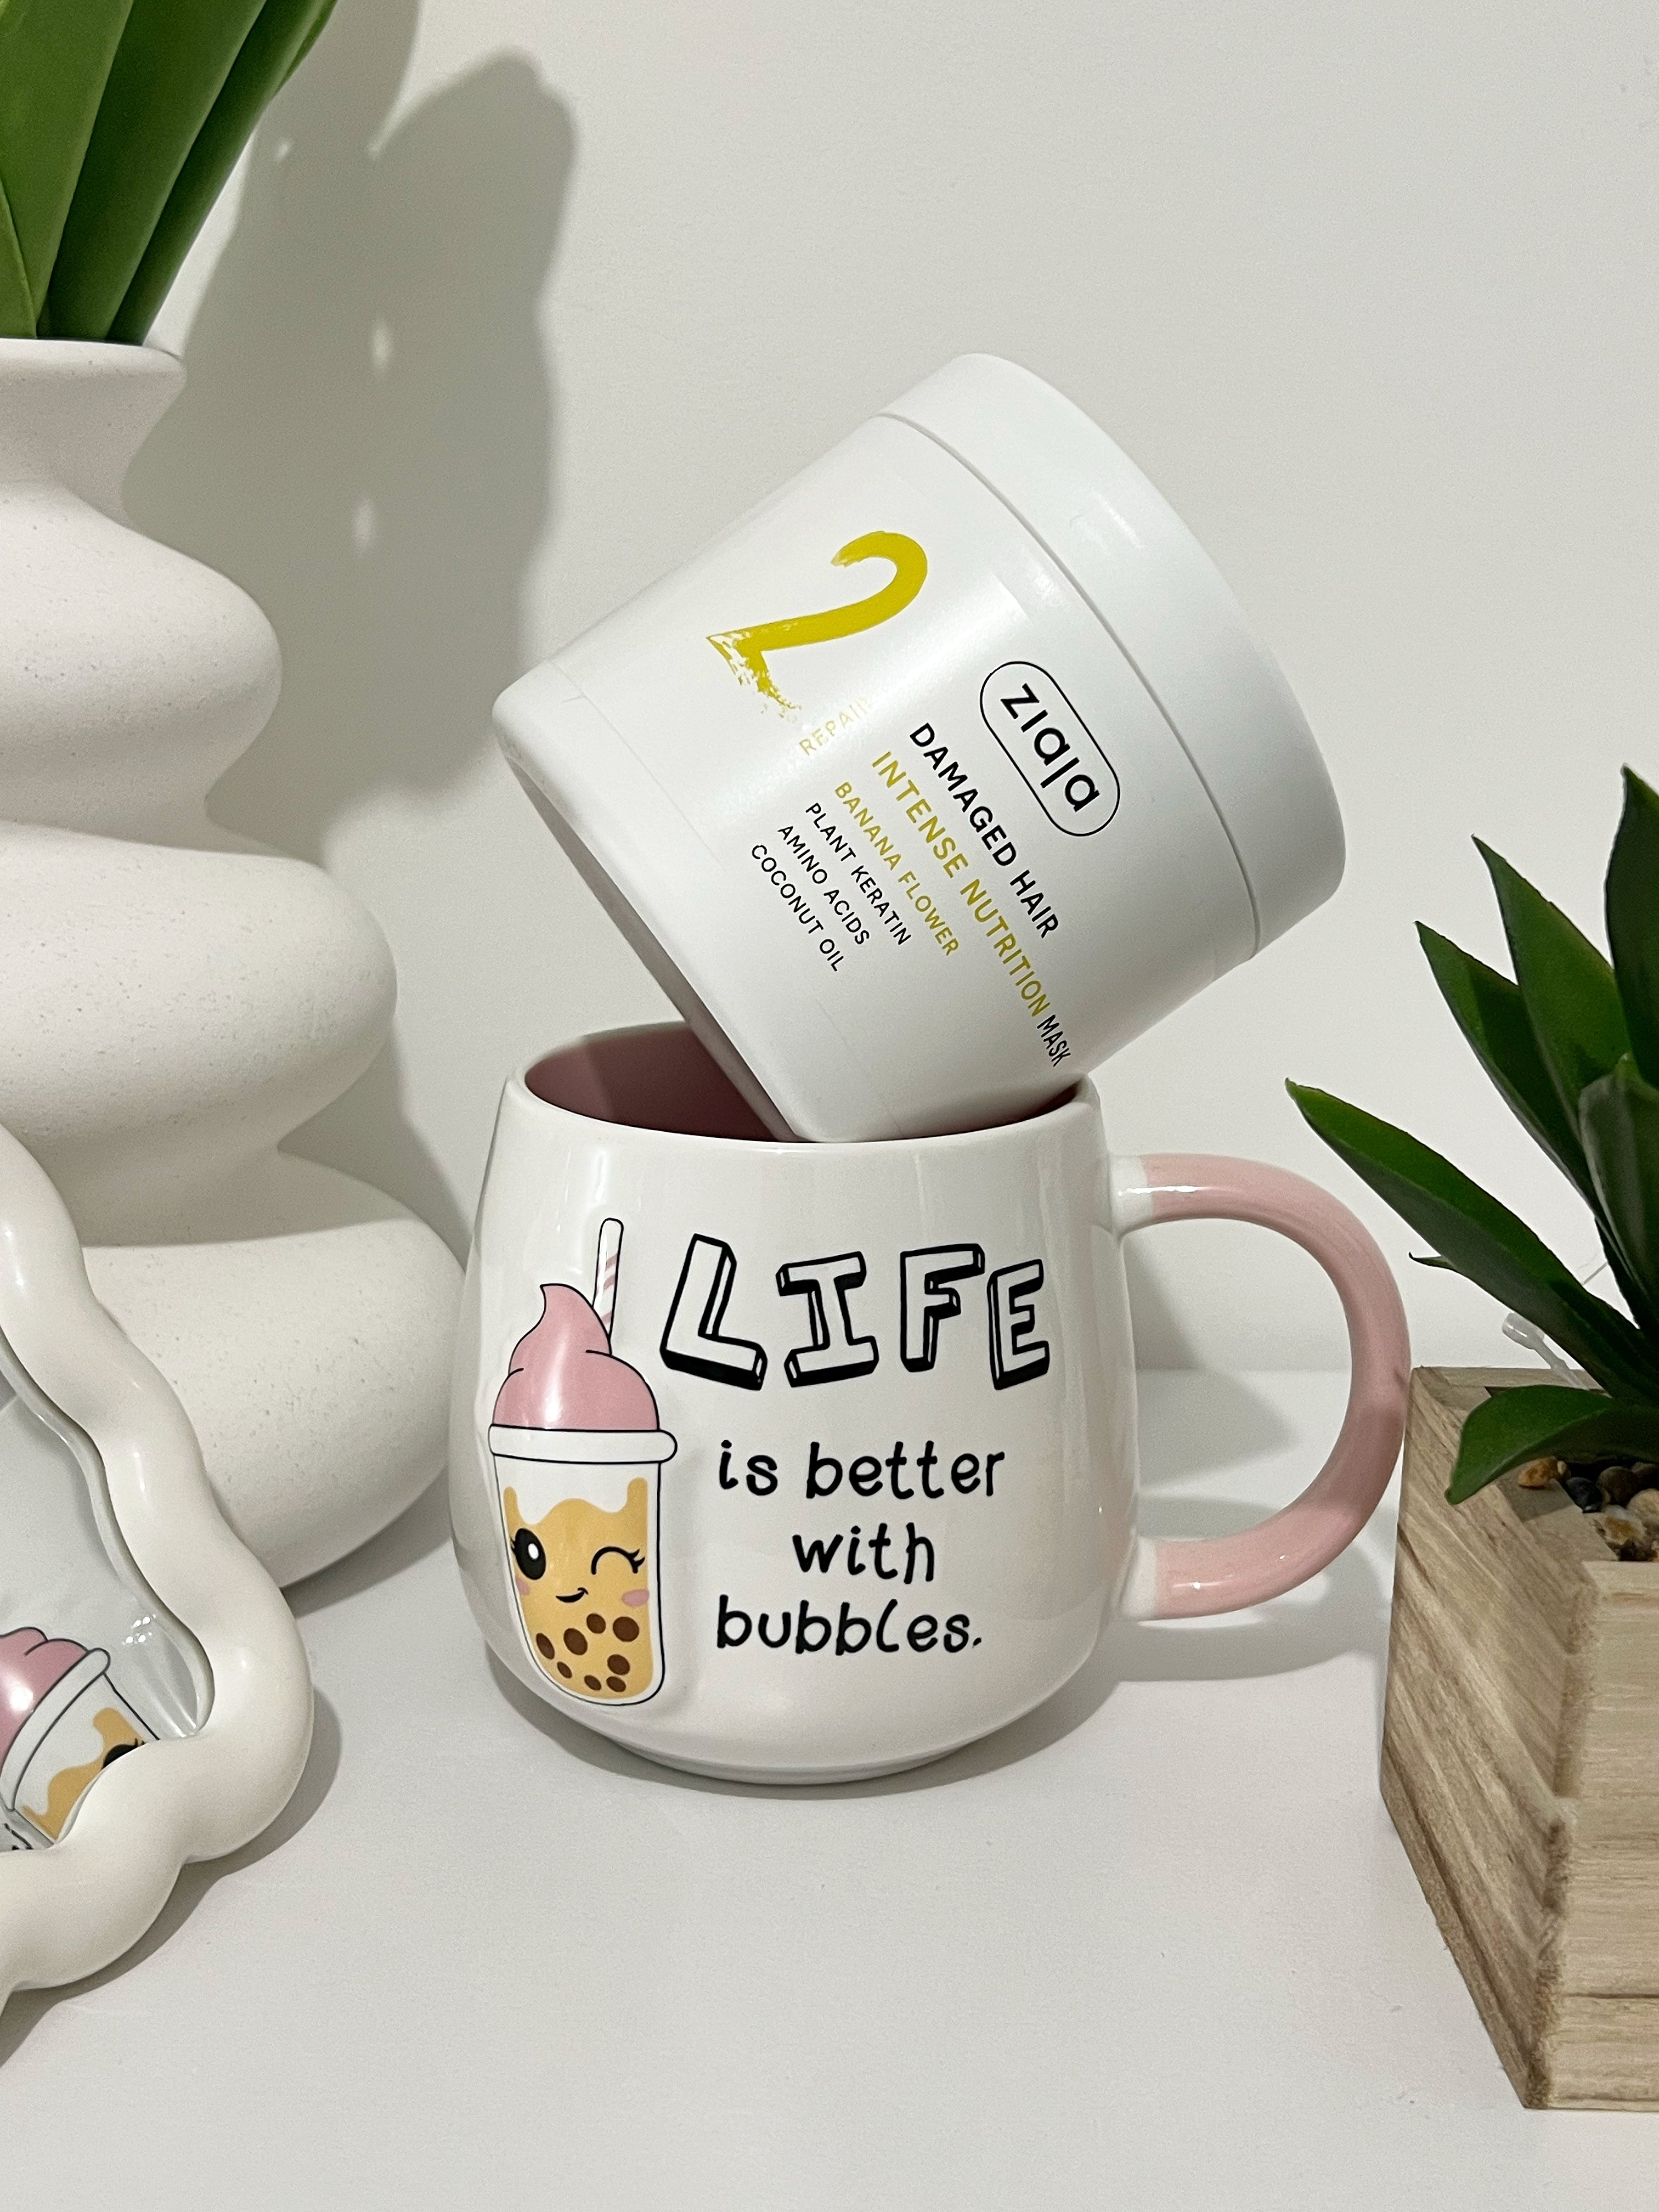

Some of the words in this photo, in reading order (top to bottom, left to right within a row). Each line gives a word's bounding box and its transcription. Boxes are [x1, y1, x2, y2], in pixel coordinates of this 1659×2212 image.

[707, 531, 928, 720] 2
[1000, 683, 1100, 812] ziaja
[777, 826, 827, 884] AMINO
[823, 890, 870, 944] ACIDS
[805, 803, 855, 861] PLANT
[853, 865, 911, 945] KERATIN
[836, 782, 901, 868] BANANA
[900, 872, 959, 956] FLOWER
[910, 723, 1017, 866] DAMAGED
[1010, 870, 1059, 939] HAIR
[752, 844, 822, 933] COCONUT
[820, 939, 844, 972] OIL
[873, 752, 968, 879] INTENSE
[961, 879, 1050, 1018] NUTRITION
[1036, 1014, 1071, 1067] MASK
[659, 1233, 1050, 1391] LIFE
[719, 1440, 778, 1496] is
[806, 1440, 1005, 1500] better
[792, 1522, 934, 1584] with
[717, 1594, 981, 1656] bubbles.
